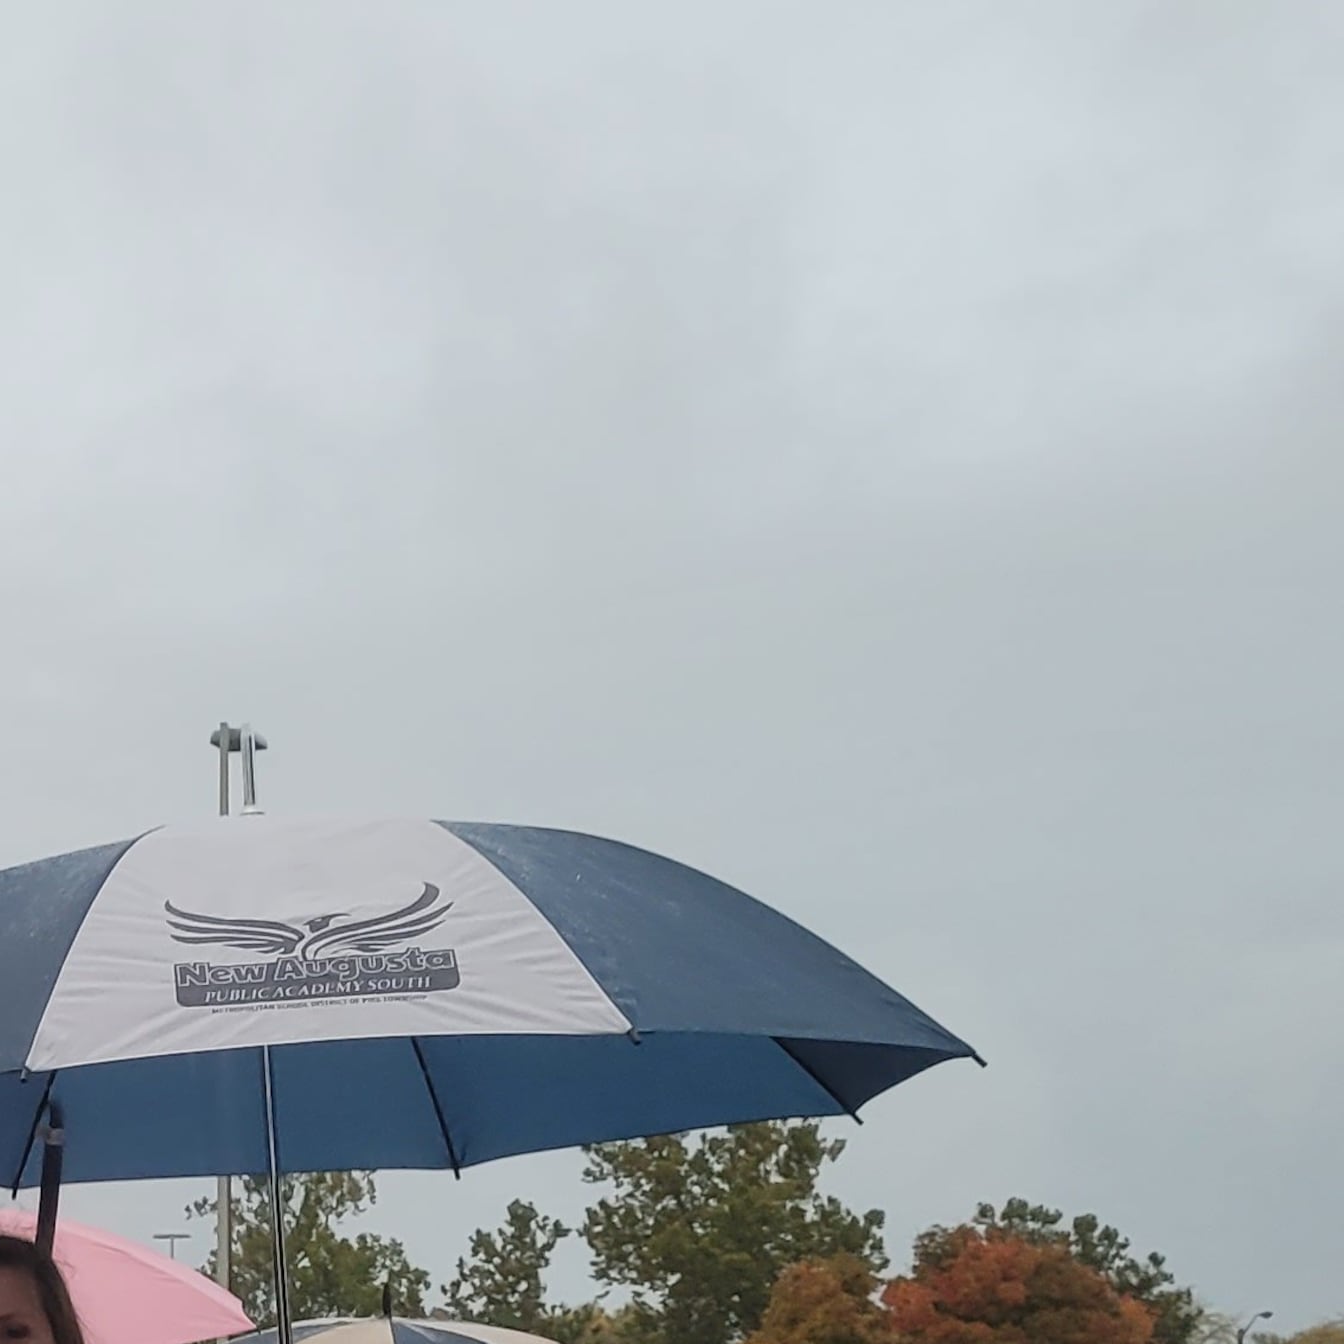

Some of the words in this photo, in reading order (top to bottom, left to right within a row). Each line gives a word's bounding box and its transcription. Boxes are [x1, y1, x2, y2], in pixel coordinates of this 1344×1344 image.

[176, 962, 267, 987] New
[275, 947, 454, 980] Augusta
[205, 987, 269, 1002] PUBLIC
[273, 981, 362, 998] ACADEMY
[368, 975, 432, 991] SOUTH
